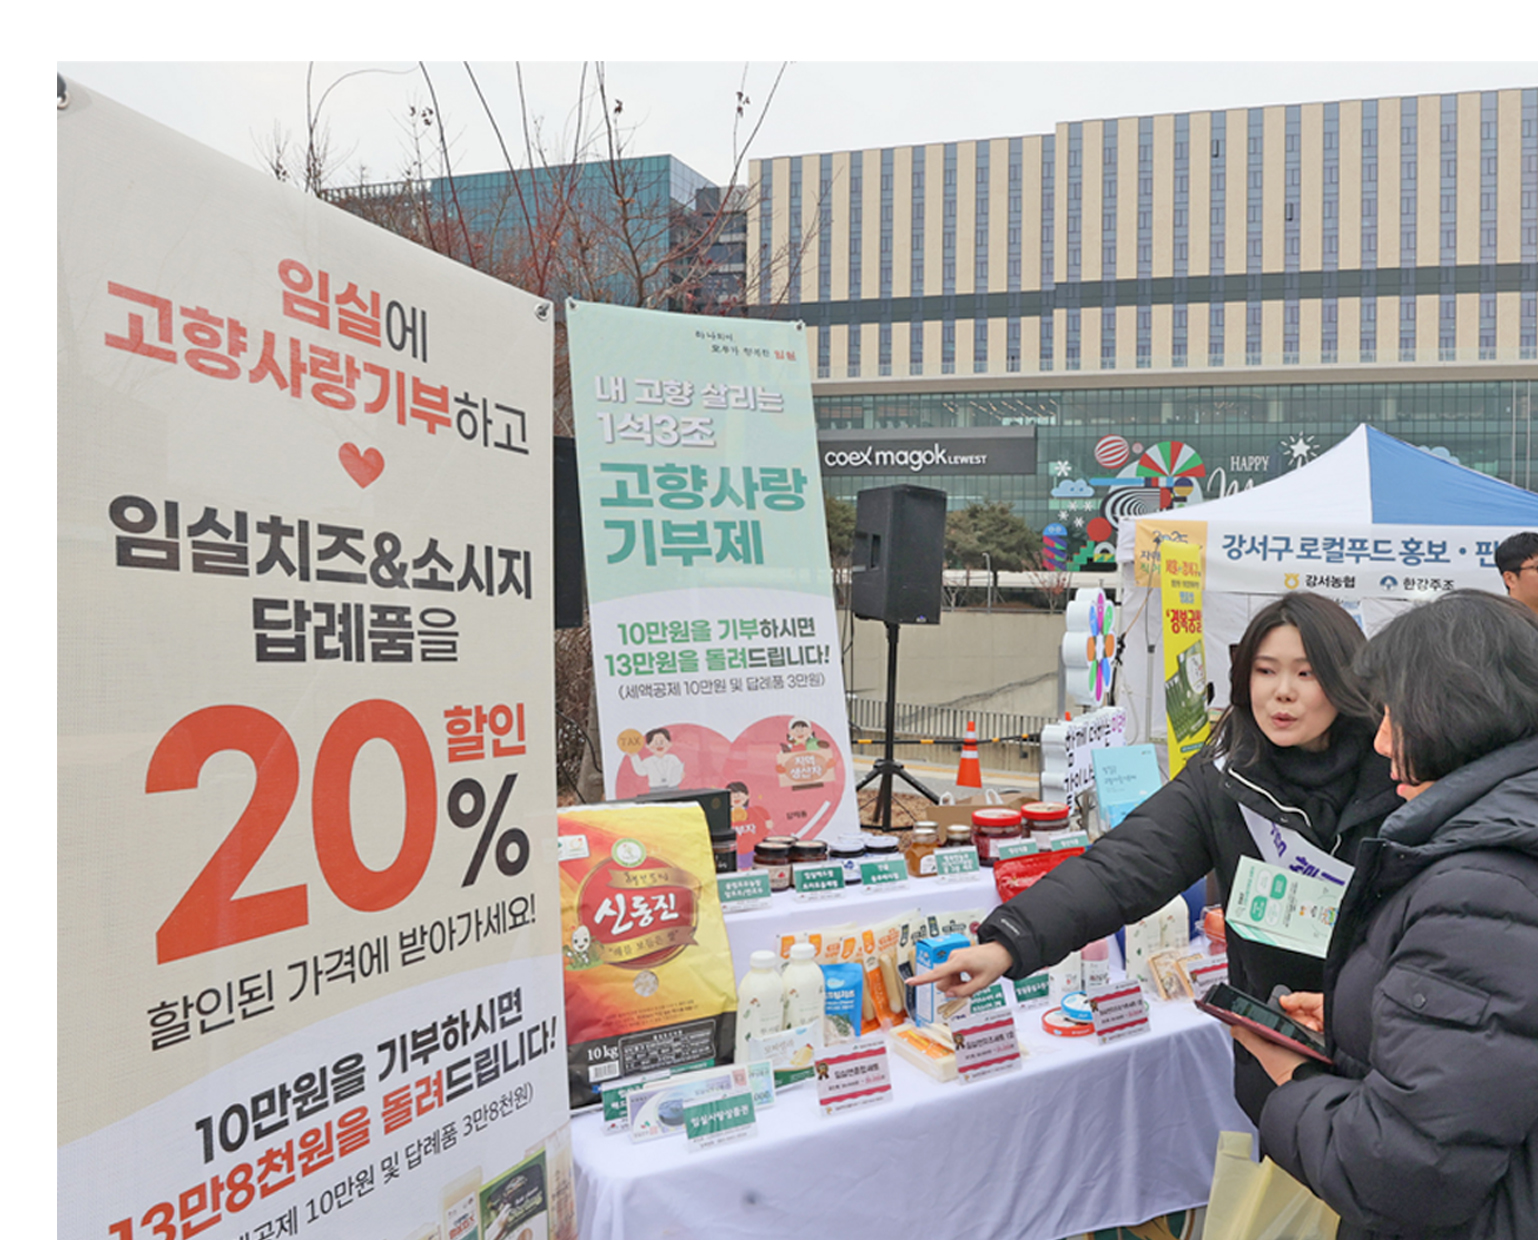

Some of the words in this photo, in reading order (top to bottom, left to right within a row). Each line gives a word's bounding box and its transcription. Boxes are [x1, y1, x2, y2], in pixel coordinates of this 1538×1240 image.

[277, 258, 428, 363] 임실에
[104, 280, 530, 456] 고향사랑기부하고
[595, 376, 626, 403] 내
[634, 379, 694, 407] 고향
[701, 382, 784, 413] 살리는
[597, 412, 716, 448] 1석3조
[824, 447, 873, 466] coex
[875, 444, 948, 471] magok
[948, 454, 988, 465] LEWEST
[1230, 455, 1269, 472] HAPPY
[599, 462, 808, 512] 고향사랑
[108, 494, 533, 600] 임실치즈&소시지
[603, 519, 765, 567] 기부제
[1222, 534, 1293, 562] 강서구
[1300, 536, 1396, 564] 로컬푸드
[1400, 537, 1451, 565] 홍보
[1305, 573, 1356, 589] 강서농협
[1403, 576, 1454, 592] 한강주조
[252, 597, 459, 663] 답례품을
[617, 619, 712, 646] 10만원을
[717, 617, 816, 640] 기부하시면
[605, 649, 700, 677] 13만원을
[705, 645, 830, 671] 돌려드립니다!
[684, 679, 727, 695] 10만원
[444, 703, 527, 764] 할인
[620, 734, 642, 747] TAX
[593, 893, 679, 935] 신동진
[147, 969, 275, 1052] 할인된
[287, 935, 390, 1003] 가격에
[399, 893, 537, 968] 받아가세요!
[588, 1049, 600, 1061] 10
[194, 1052, 366, 1165] 10만원을
[376, 986, 524, 1083] 기부하시면
[380, 1016, 558, 1137] 돌려드립니다!
[305, 1165, 375, 1227] 10만원
[380, 1155, 400, 1185] 및
[403, 1127, 459, 1172] 답례품
[461, 1081, 534, 1139] 3만8천원)
